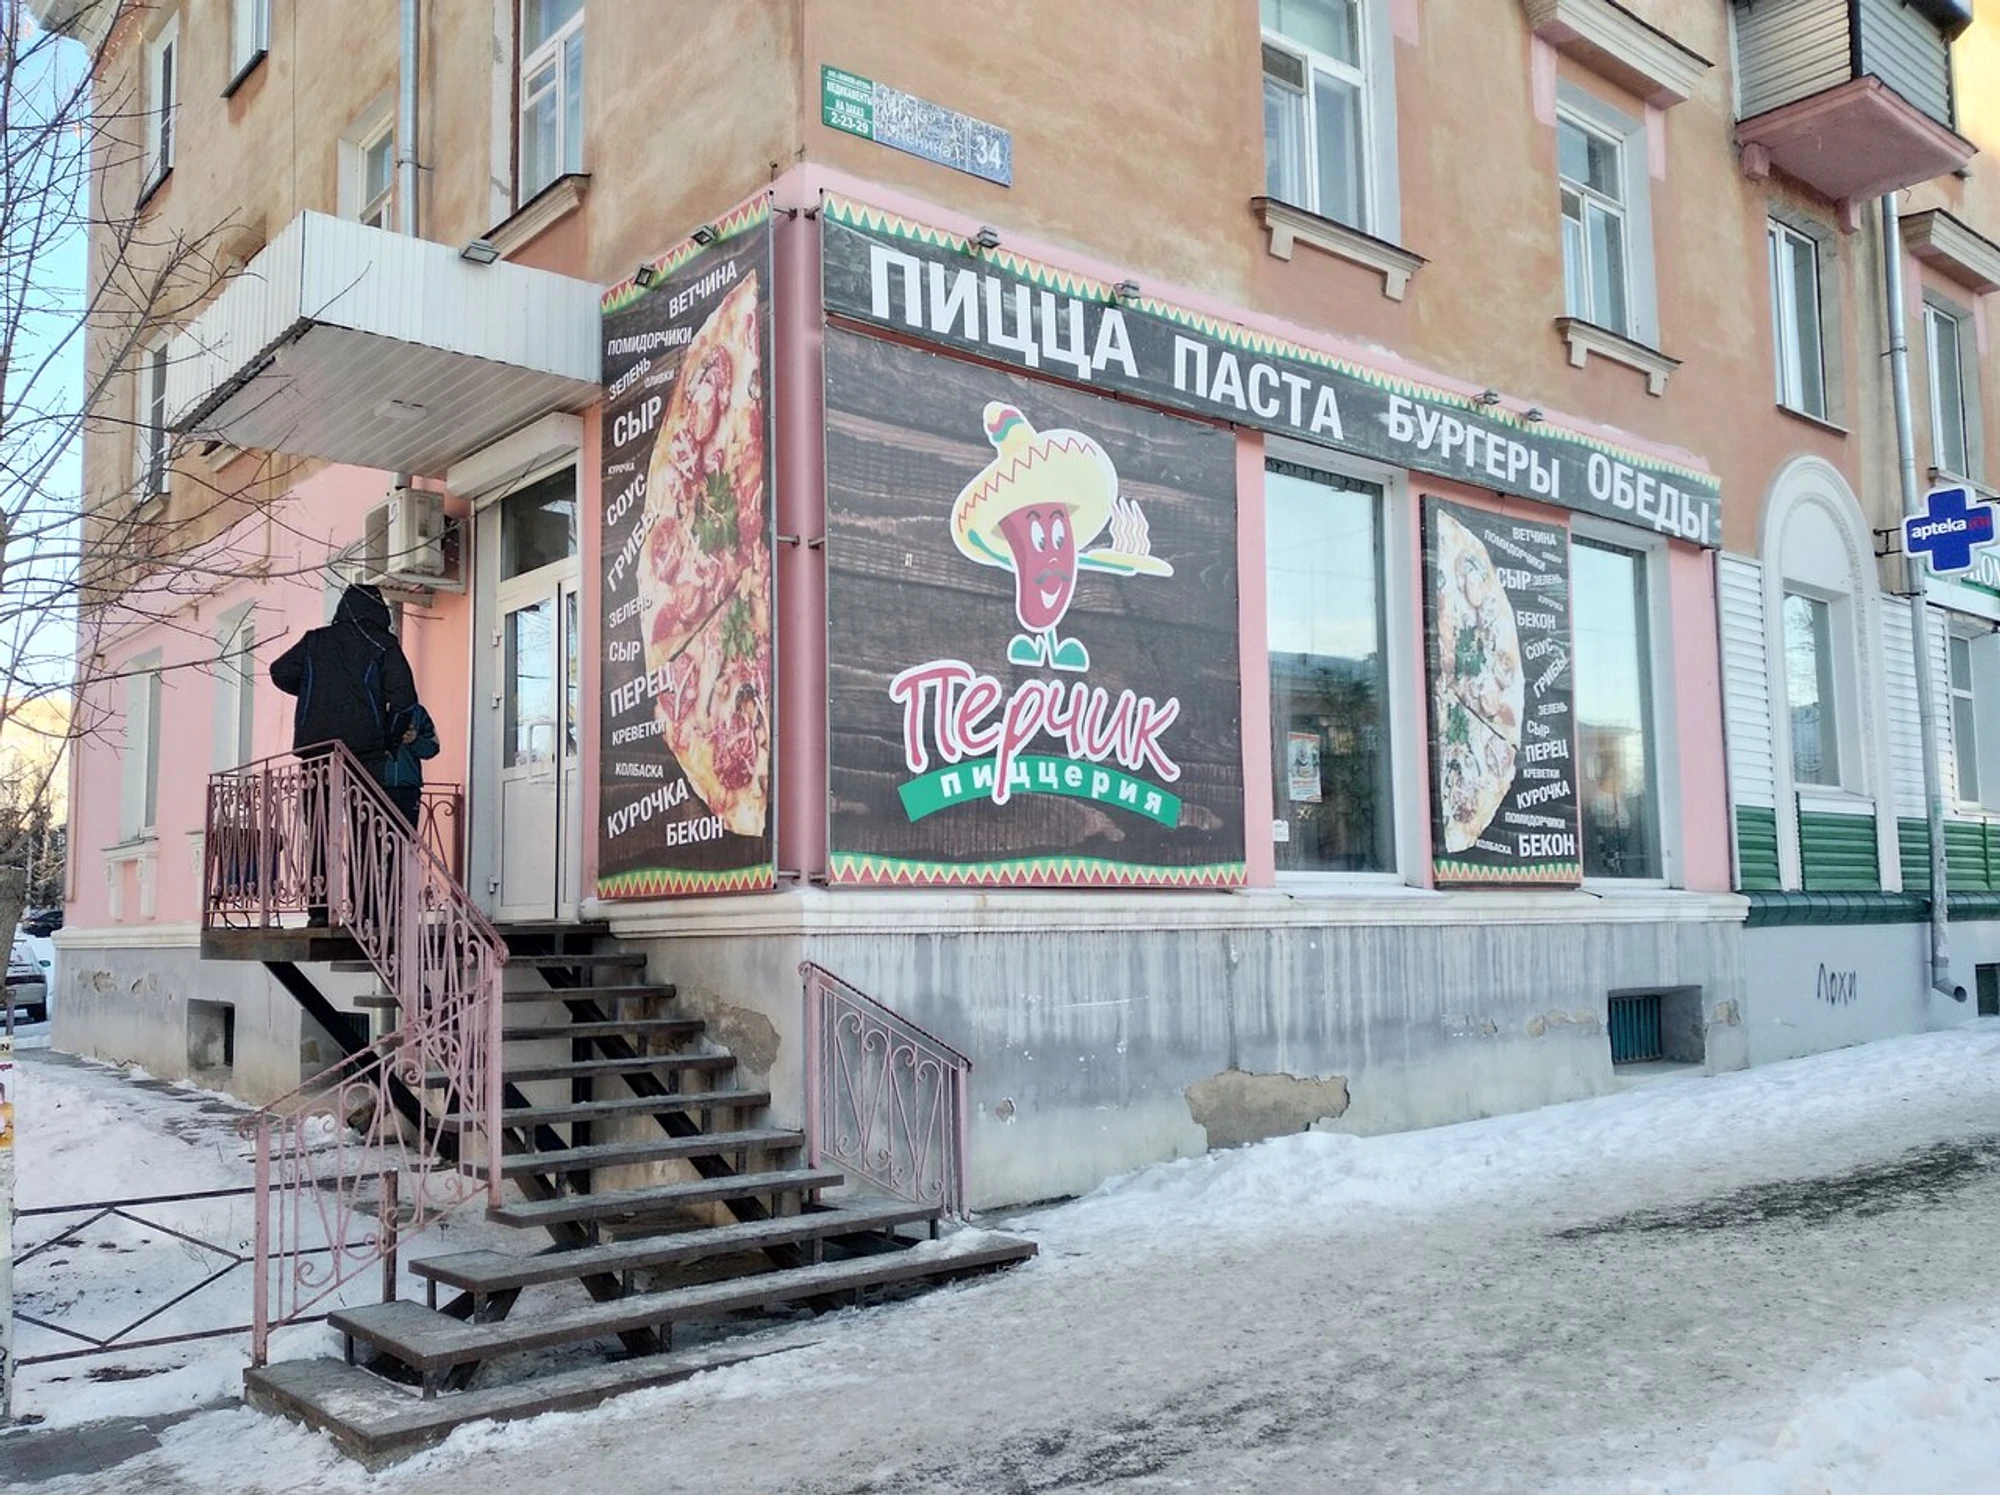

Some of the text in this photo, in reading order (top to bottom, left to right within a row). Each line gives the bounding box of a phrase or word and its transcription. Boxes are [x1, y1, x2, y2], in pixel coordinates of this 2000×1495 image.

[831, 111, 869, 134] 2-23-29
[976, 134, 1002, 169] 34
[669, 260, 737, 318] ВЕТЧИНА
[608, 327, 692, 356] ПОМИДОРЧИКИ
[609, 358, 651, 400] ЗЕЛЕНЬ
[870, 245, 1709, 544] ПИЦЦА ПАСТА БУРГЕРЫ ОБЕДЫ
[614, 396, 661, 447] СЫР
[607, 474, 645, 526] СОУС
[607, 502, 659, 592] ГРИБЫ
[1484, 530, 1546, 572] ПОМИДОРЧИКИ
[1512, 527, 1557, 546] ВЕТЧИНА
[1497, 567, 1531, 590] СЫР
[609, 595, 652, 628] ЗЕЛЕНЬ
[1517, 611, 1556, 629] БЕКОН
[609, 641, 641, 662] СЫР
[1526, 638, 1553, 660] СОУС
[1533, 649, 1569, 698] ГРИБЫ
[610, 662, 675, 717] ПЕРЕЦ
[612, 720, 666, 746] КРЕВЕТКИ
[889, 660, 1181, 804] Перчик
[1527, 720, 1550, 738] СЫР
[1525, 739, 1569, 762] ПЕРЕЦ
[615, 763, 663, 778] КОЛБАСКА
[1523, 768, 1560, 779] КРЕВЕТКИ
[940, 758, 1162, 816] пиццерия
[1516, 780, 1571, 809] КУРОЧКА
[607, 778, 689, 838] КУРОЧКА
[1505, 812, 1565, 829] ПОМИДОРЧИКИ
[666, 816, 724, 846] БЕКОН
[1519, 834, 1575, 857] БЕКОН
